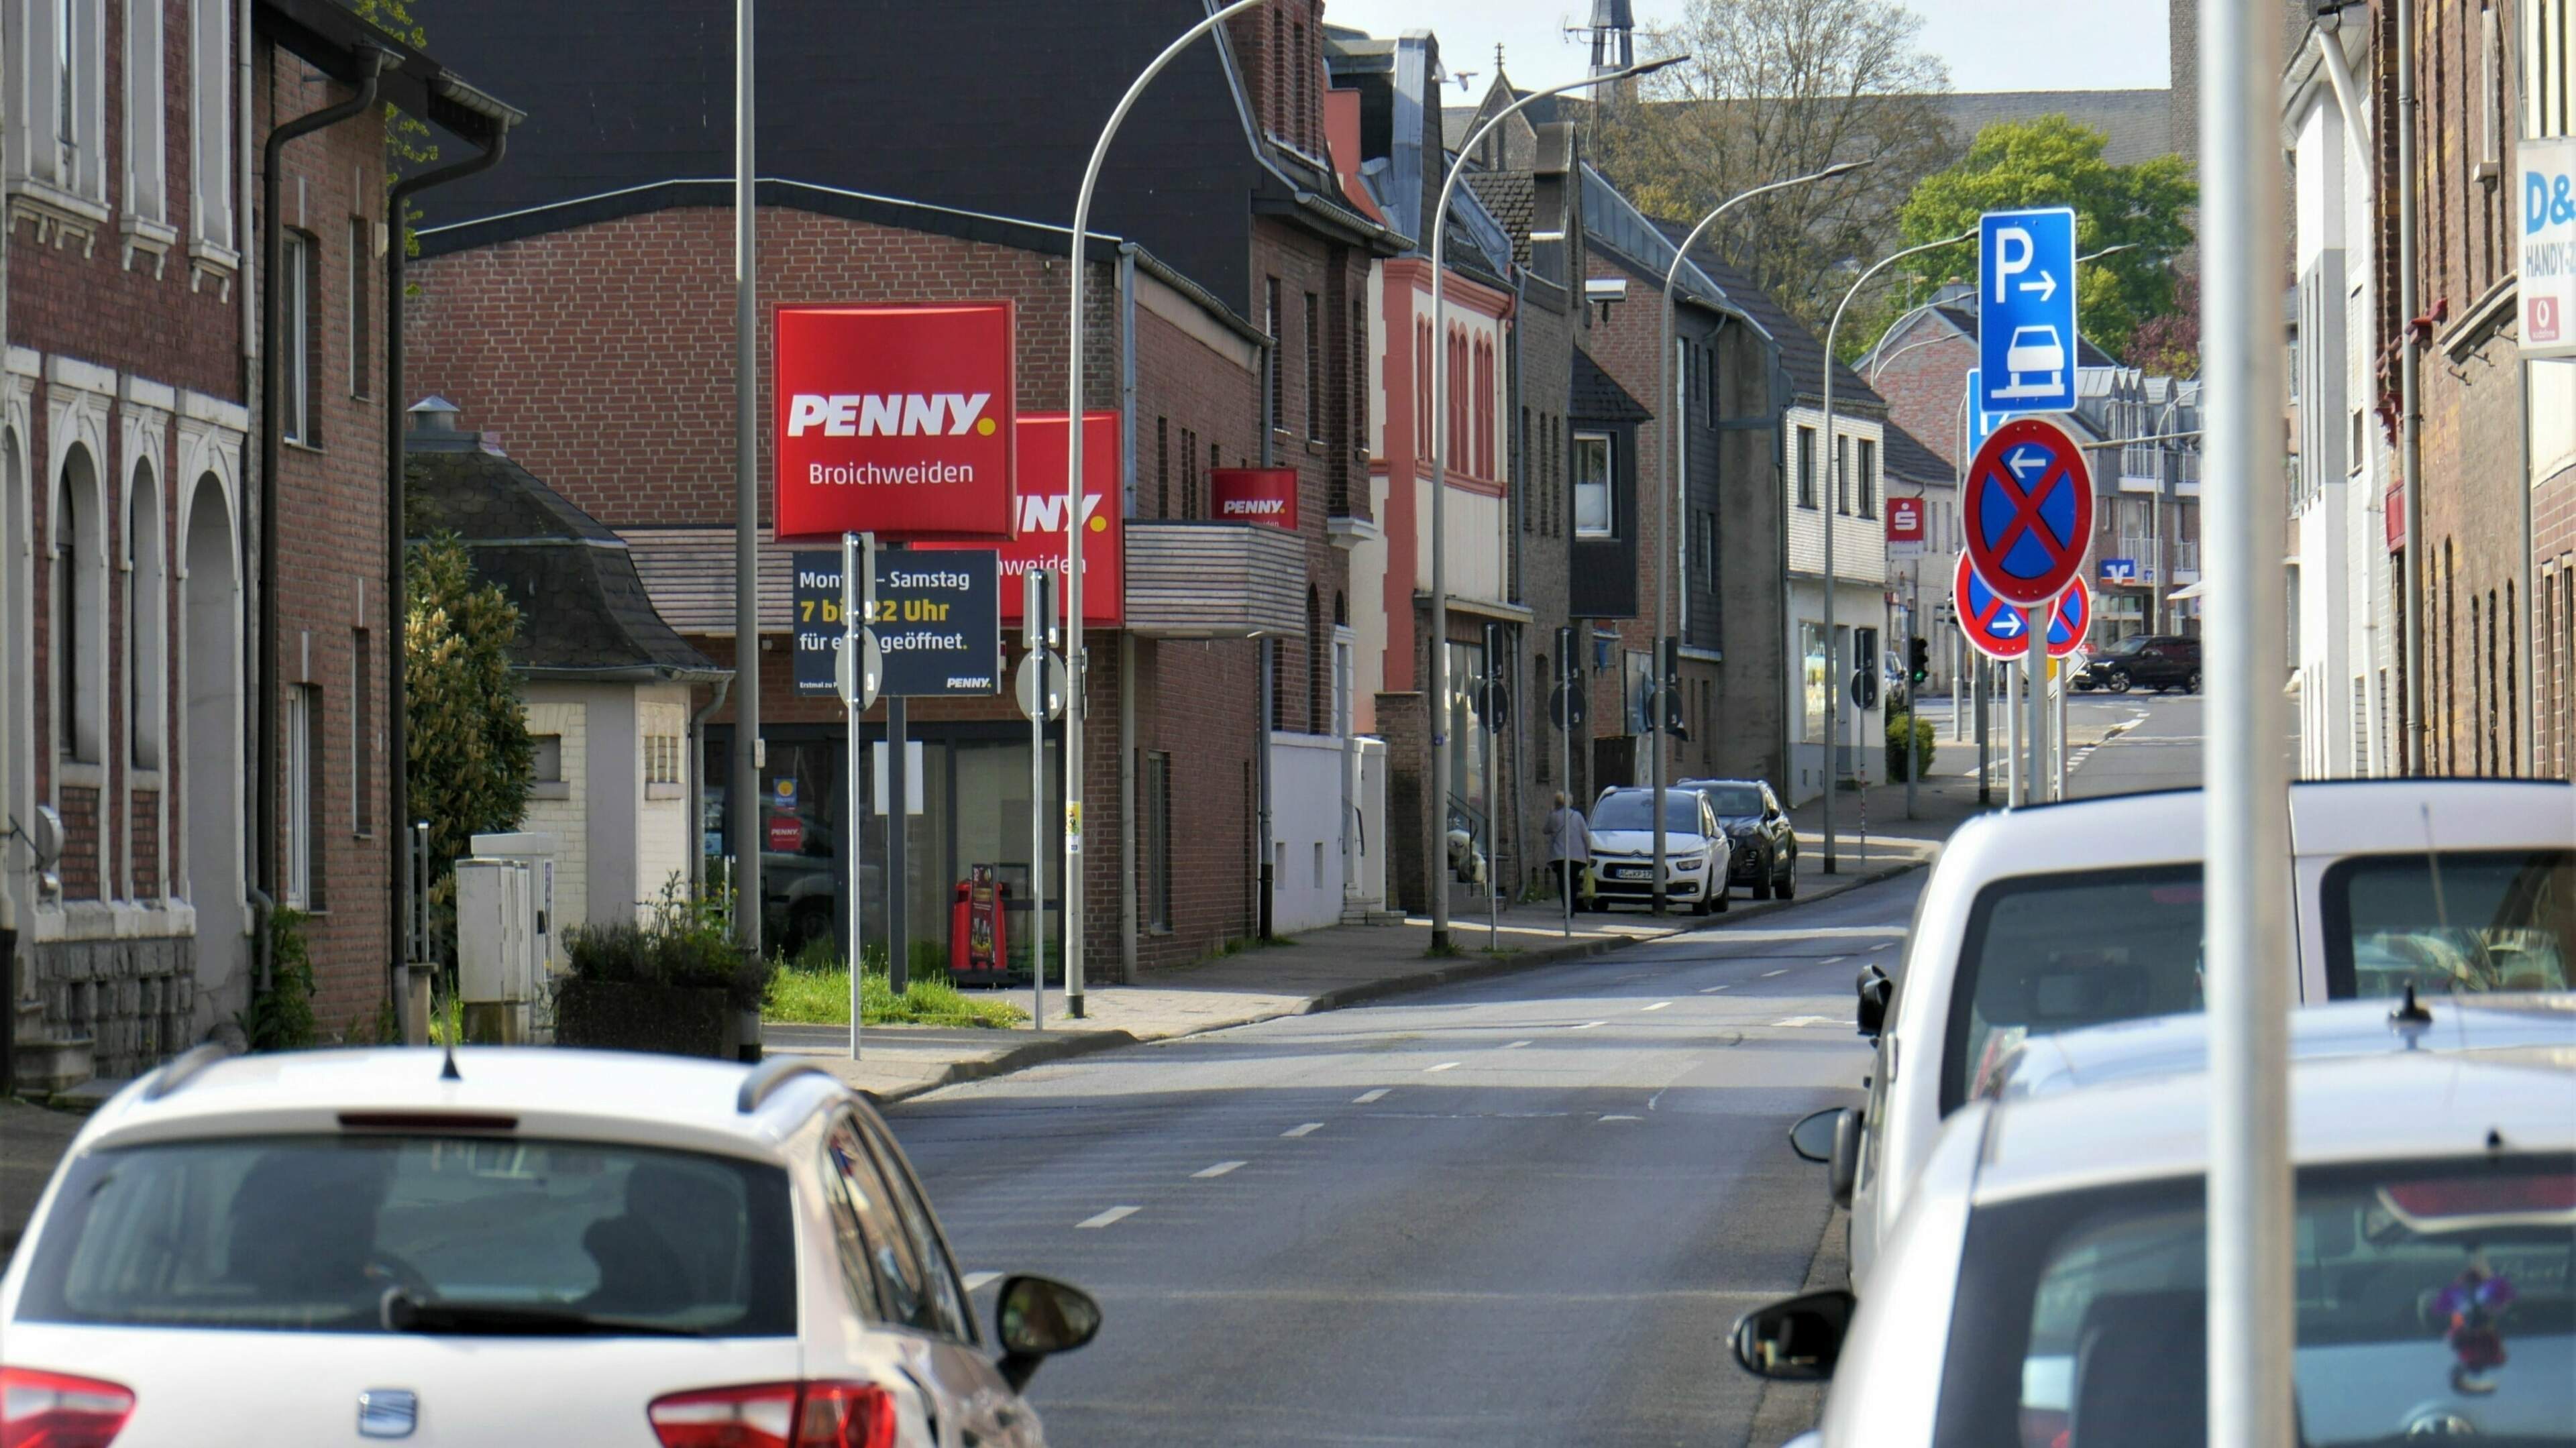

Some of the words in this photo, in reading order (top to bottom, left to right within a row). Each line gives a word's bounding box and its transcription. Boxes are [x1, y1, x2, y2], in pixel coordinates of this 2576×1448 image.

[1996, 227, 2034, 303] P
[809, 461, 973, 485] Broichweiden
[800, 572, 843, 588] Mon
[890, 571, 970, 590] Samstag
[800, 601, 815, 622] 7
[905, 599, 950, 622] Uhr
[800, 632, 828, 651] für
